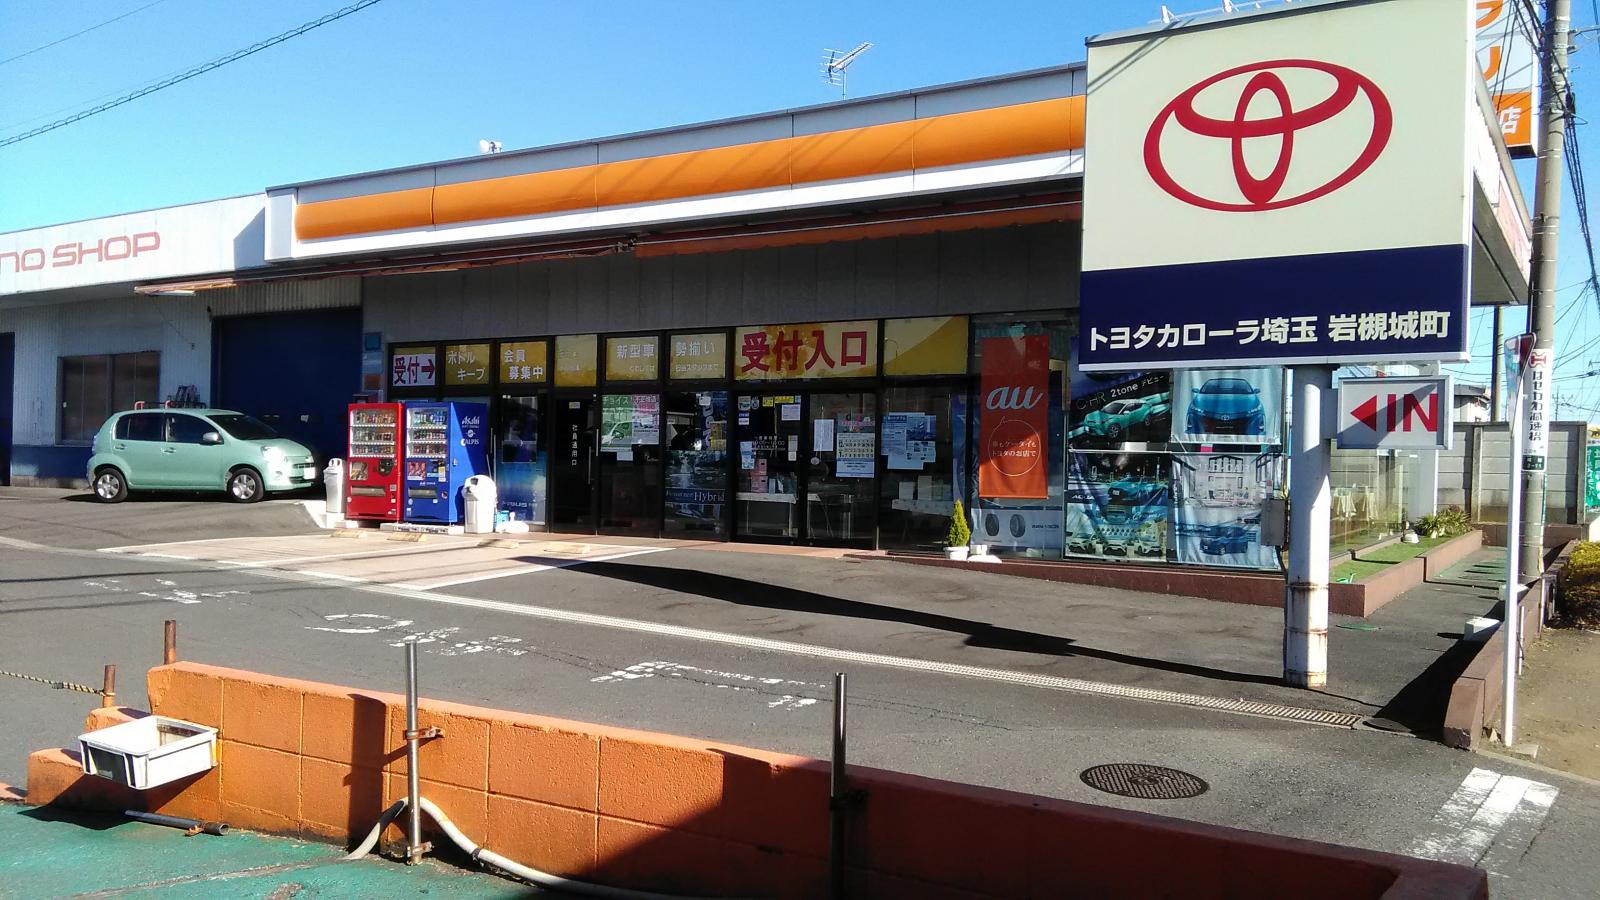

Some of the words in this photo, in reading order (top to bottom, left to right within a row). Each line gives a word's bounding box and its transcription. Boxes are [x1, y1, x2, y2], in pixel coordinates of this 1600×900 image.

[52, 231, 161, 268] SHOP
[1089, 315, 1318, 351] トヨタカローラ埼玉
[1328, 310, 1451, 343] 岩槻城町
[504, 349, 525, 363] 会員
[616, 343, 655, 359] 新型車
[675, 341, 715, 357] 勢揃い
[741, 330, 868, 373] 受付入口
[393, 356, 420, 385] 受付
[457, 367, 486, 381] キープ
[509, 365, 544, 381] 募集中
[985, 384, 1044, 411] au
[1110, 382, 1139, 399] 2tone
[1386, 393, 1439, 433] IN
[694, 491, 725, 503] Hybrid
